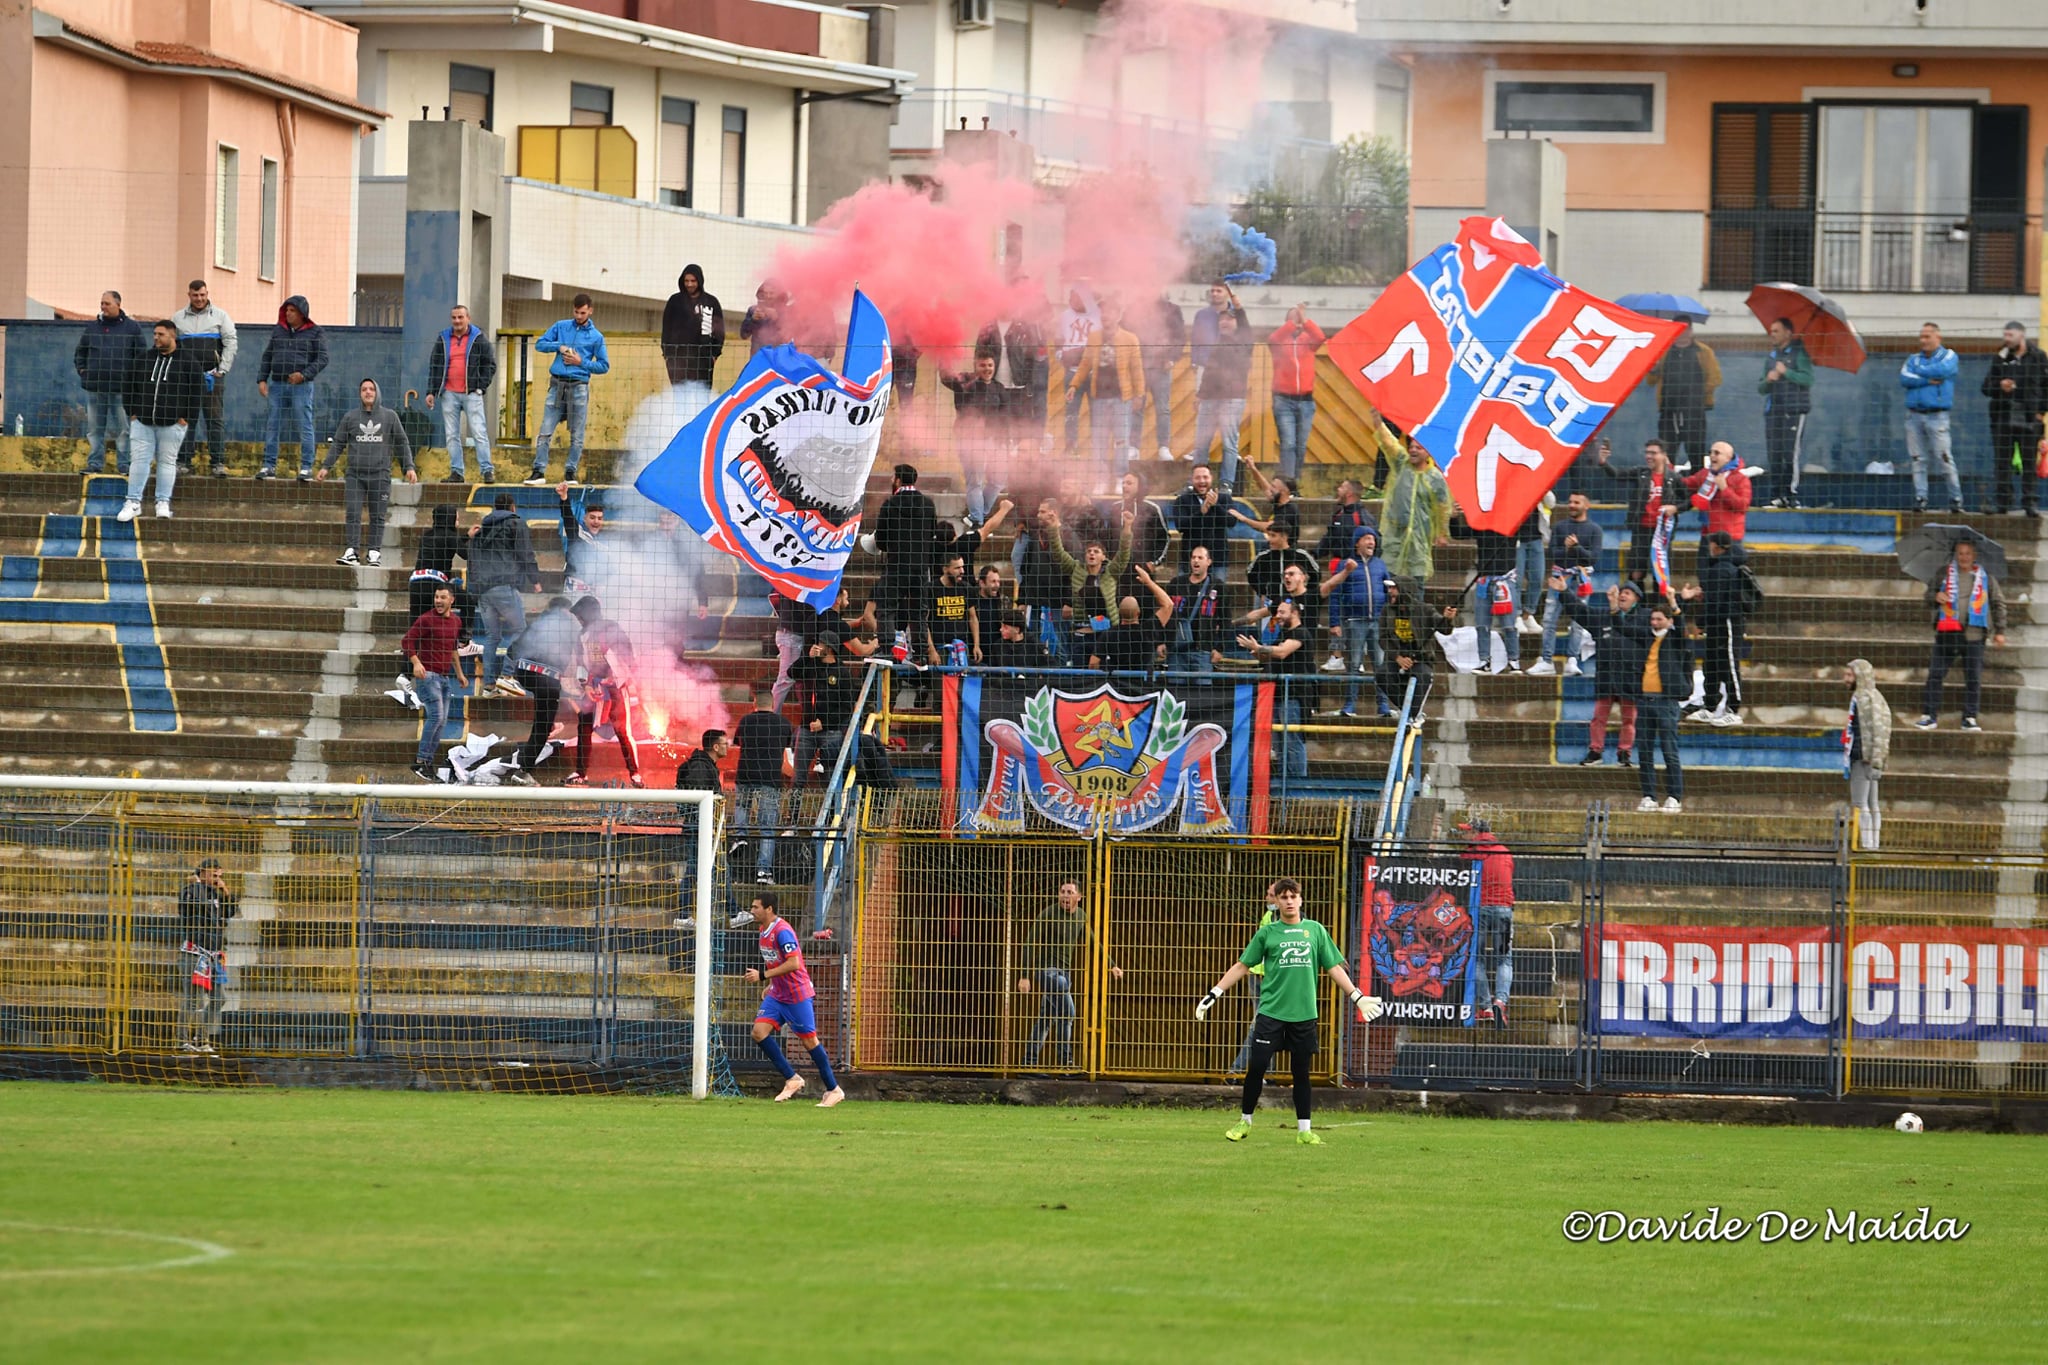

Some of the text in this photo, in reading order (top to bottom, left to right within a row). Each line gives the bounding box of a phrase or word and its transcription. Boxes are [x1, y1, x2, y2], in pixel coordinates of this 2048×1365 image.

[355, 433, 384, 442] adidas
[990, 754, 1016, 814] Curva
[1074, 774, 1128, 793] 1908
[1191, 769, 1214, 814] Sud
[1367, 865, 1480, 887] PATERNESI
[1378, 1001, 1456, 1021] VIMENTO
